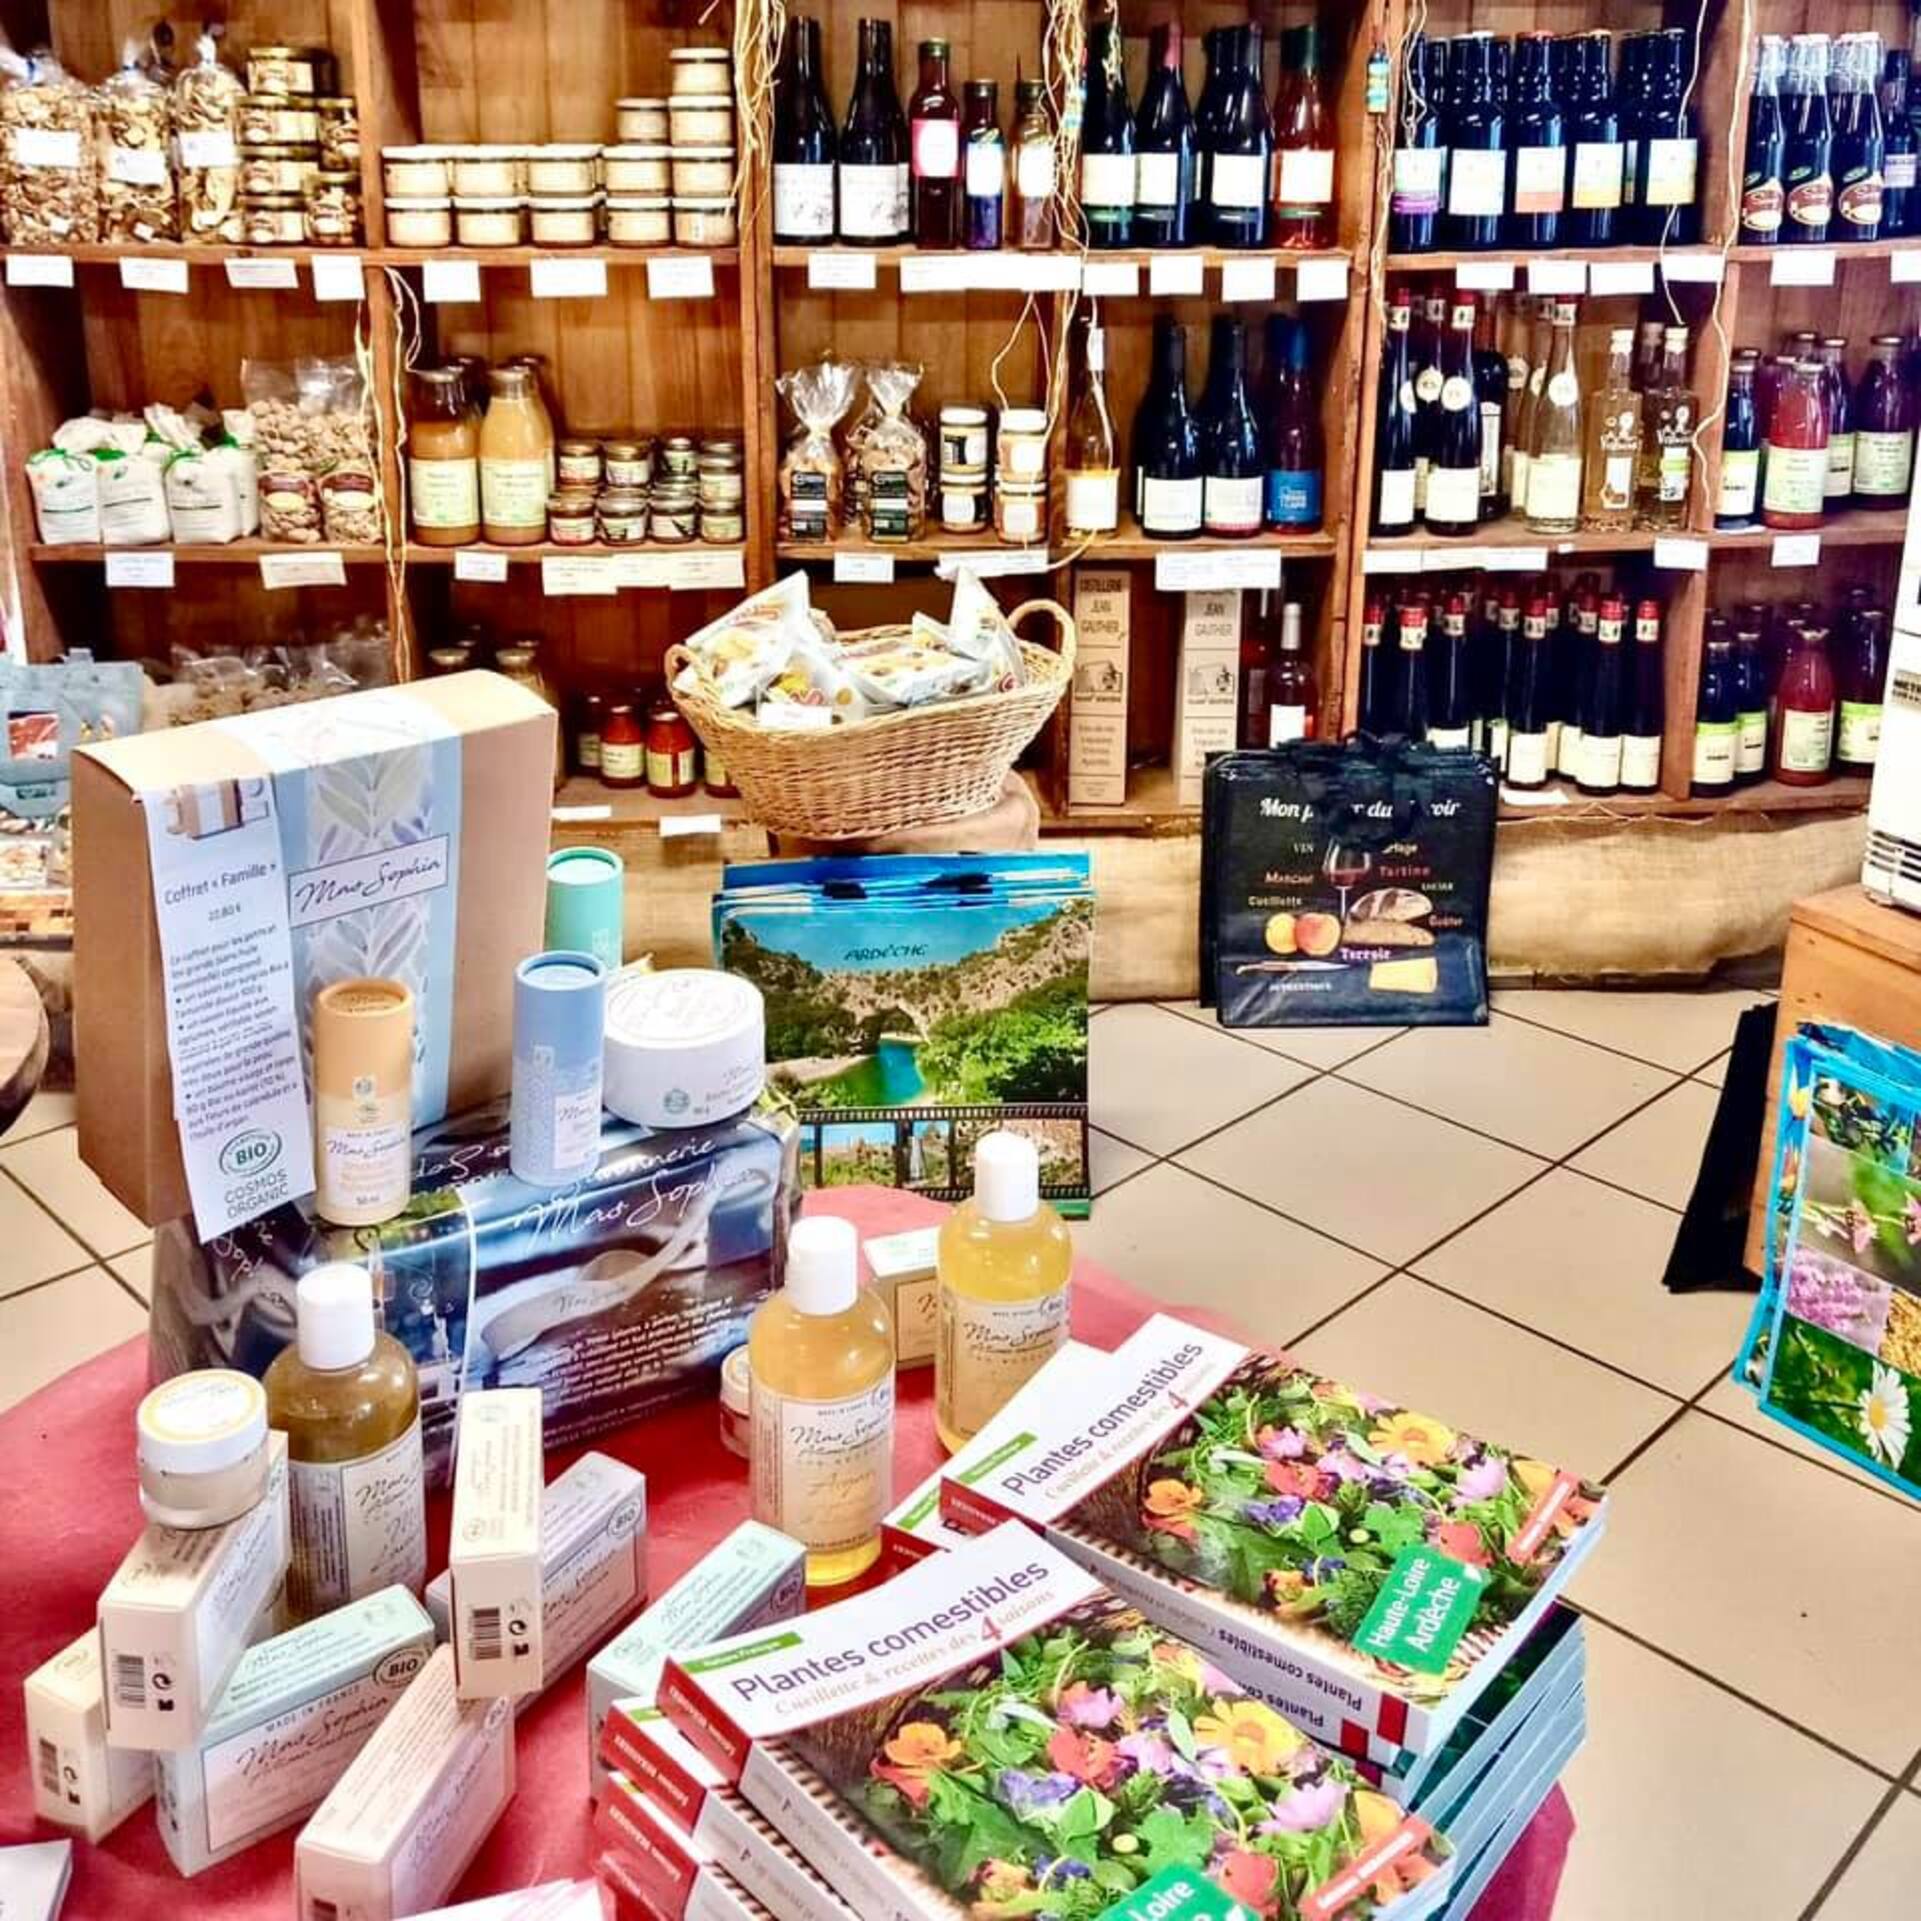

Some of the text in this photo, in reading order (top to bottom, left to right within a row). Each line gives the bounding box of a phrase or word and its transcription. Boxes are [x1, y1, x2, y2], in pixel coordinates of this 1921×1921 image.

[1260, 798, 1299, 818] Mon
[1367, 800, 1393, 818] du
[164, 880, 209, 905] Coffret
[221, 864, 267, 887] Famille
[1341, 948, 1391, 961] Terroir
[236, 1142, 268, 1166] BIO
[224, 1169, 288, 1203] COSMOS
[227, 1182, 289, 1218] ORGANIC
[1168, 1390, 1191, 1410] 4
[1002, 1436, 1093, 1496] Plantes
[1089, 1343, 1202, 1438] comestibles
[1366, 1556, 1431, 1648] Haute-Loire
[1404, 1576, 1462, 1652] Ardèche
[732, 1645, 866, 1702] Plantes
[868, 1560, 1050, 1659] comestibles
[389, 1658, 418, 1677] BIO
[774, 1677, 861, 1717] Cueillette
[864, 1671, 882, 1687] &
[883, 1648, 946, 1679] recettes
[979, 1615, 1003, 1643] 4
[1218, 1628, 1304, 1678] comestibles
[1267, 1691, 1325, 1728] Plantes
[1305, 1672, 1363, 1713] Plantes
[265, 1714, 298, 1733] MADE
